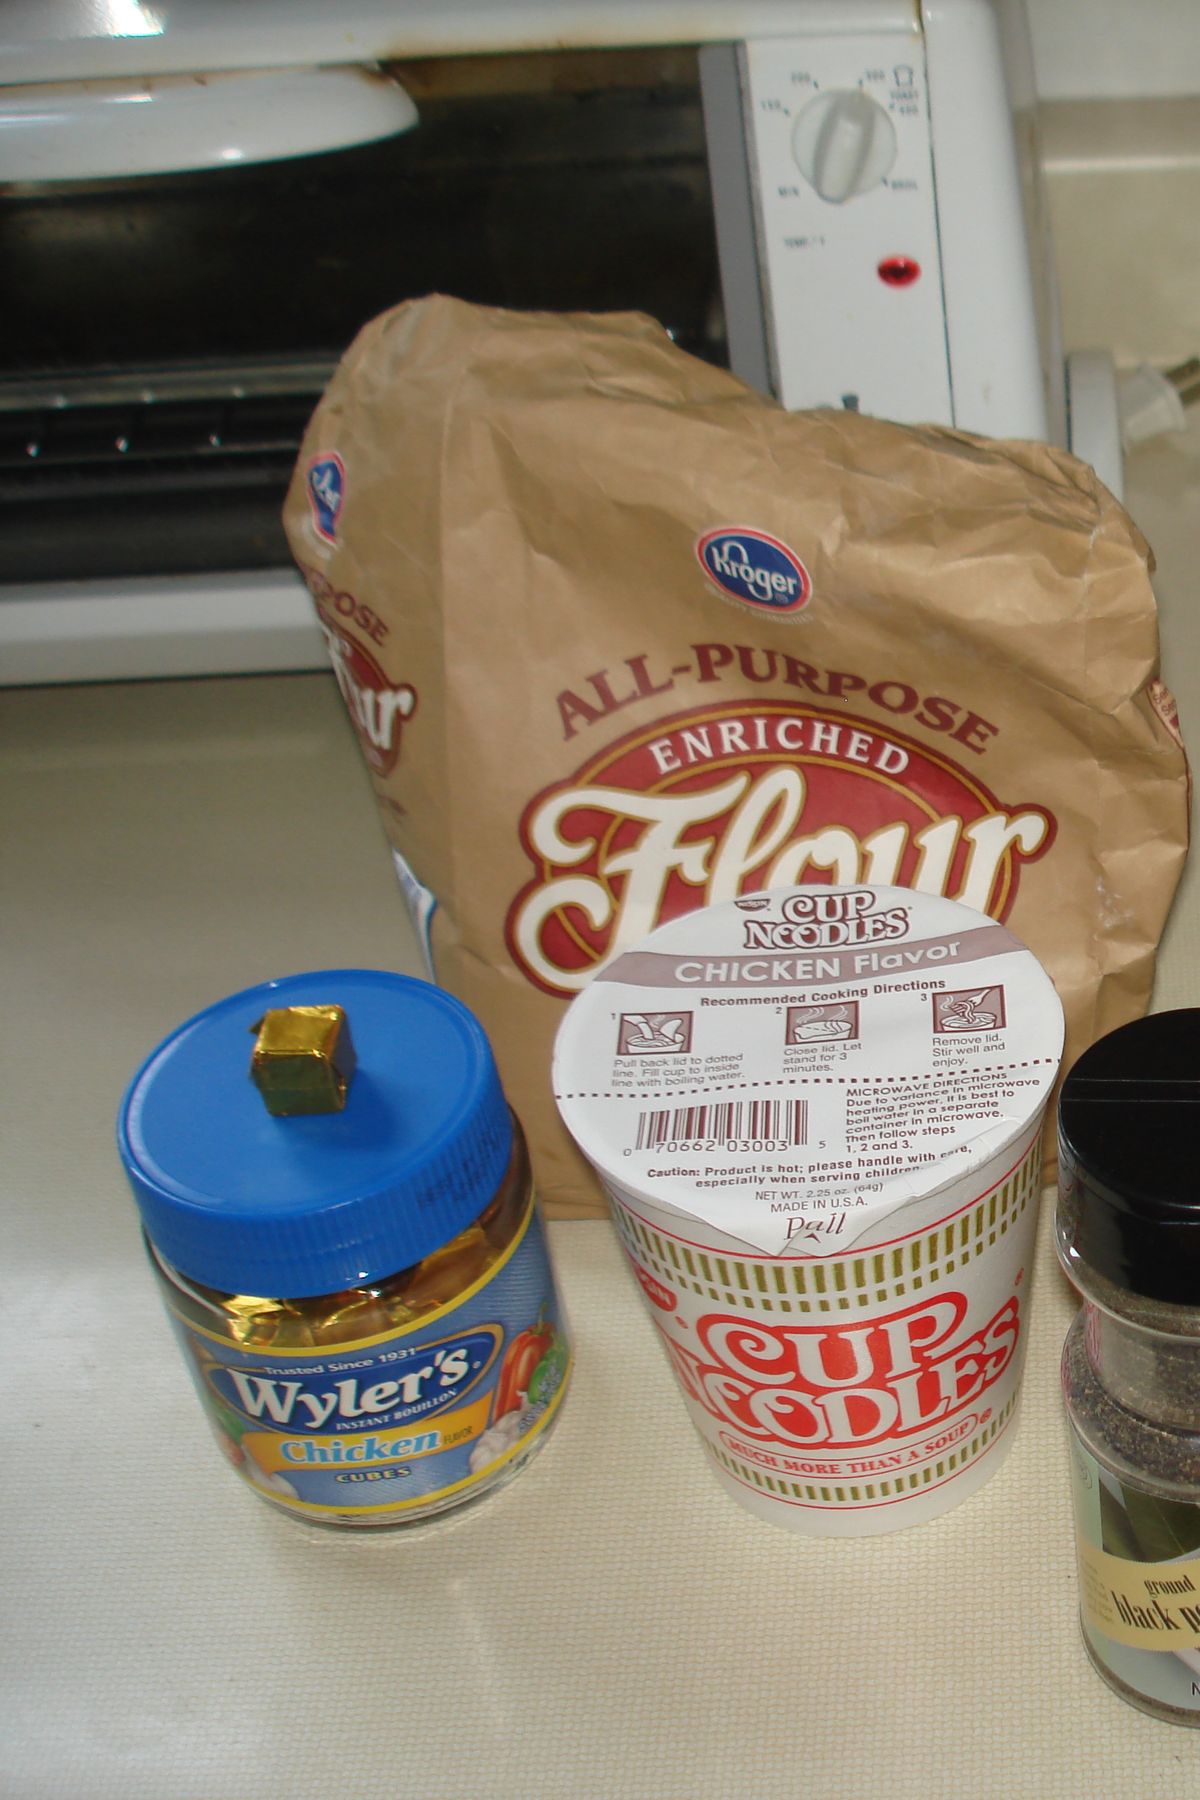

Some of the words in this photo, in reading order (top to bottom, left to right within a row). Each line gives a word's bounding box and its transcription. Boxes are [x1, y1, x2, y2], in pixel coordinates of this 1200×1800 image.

[710, 540, 798, 602] Kroger
[554, 642, 999, 756] ALL-PURPOSE
[648, 717, 910, 775] ENRICHED
[782, 890, 877, 923] CUP
[743, 906, 910, 951] NOODLES
[674, 958, 841, 984] CHICKEN
[853, 941, 961, 975] Flavor
[700, 994, 806, 1007] Recommended
[811, 986, 868, 1003] Cooking
[873, 979, 947, 994] Directions
[921, 993, 928, 1002] 3
[775, 1006, 783, 1015] 2
[783, 1047, 817, 1057] Close
[843, 1043, 862, 1052] Let
[932, 1036, 977, 1047] Remove
[932, 1047, 953, 1057] Stir
[956, 1045, 979, 1055] well
[983, 1042, 1005, 1053] and
[614, 1059, 637, 1068] Pull
[640, 1058, 670, 1067] back
[673, 1057, 687, 1066] lid
[690, 1057, 701, 1065] to
[705, 1053, 743, 1064] dotted
[663, 1068, 685, 1078] cup
[704, 1062, 740, 1073] inside
[783, 1054, 817, 1065] stand
[819, 1053, 836, 1062] for
[839, 1052, 847, 1061] 3
[783, 1063, 833, 1074] minutes.
[932, 1057, 968, 1069] enjoy.
[637, 1078, 662, 1087] with
[846, 1083, 930, 1097] MICROWAVE
[933, 1072, 1008, 1088] DIRECTIONS
[846, 1098, 872, 1107] Due
[875, 1096, 888, 1104] to
[891, 1088, 949, 1102] variance
[967, 1078, 1041, 1092] microwave
[846, 1105, 895, 1117] heating
[971, 1090, 998, 1100] best
[1002, 1089, 1015, 1097] to
[846, 1116, 870, 1126] boil
[873, 1111, 909, 1123] water
[913, 1107, 924, 1115] in
[940, 1100, 999, 1113] separate
[845, 1119, 907, 1134] container
[911, 1116, 923, 1125] in
[926, 1109, 1004, 1124] microwave.
[845, 1133, 876, 1143] Then
[879, 1129, 918, 1140] follow
[921, 1125, 956, 1136] steps
[623, 1147, 632, 1157] 0
[655, 1139, 716, 1154] 70662
[727, 1140, 789, 1153] 03003
[819, 1140, 827, 1150] 5
[860, 1143, 868, 1152] 2
[871, 1141, 897, 1151] and
[901, 1139, 913, 1149] 3.
[647, 1166, 701, 1178] Caution:
[704, 1165, 757, 1177] Product
[761, 1164, 773, 1174] is
[807, 1161, 852, 1174] please
[857, 1155, 903, 1168] handle
[907, 1152, 936, 1164] with
[696, 1174, 767, 1188] especially
[770, 1174, 806, 1184] when
[810, 1170, 861, 1184] serving
[755, 1191, 778, 1201] NET
[806, 1188, 831, 1198] 2.25
[853, 1182, 884, 1194] (64g)
[770, 1202, 809, 1213] MADE
[812, 1199, 826, 1210] IN
[830, 1196, 868, 1208] U.S.A.
[698, 1292, 965, 1389] CUP
[265, 1364, 324, 1376] Trusted
[327, 1358, 374, 1373] Since
[378, 1347, 417, 1364] 1931
[664, 1298, 1020, 1450] NOODLES
[225, 1348, 469, 1430] Wyler's
[335, 1414, 390, 1432] INSTANT
[394, 1388, 458, 1421] BOUILLON
[280, 1429, 442, 1465] Chicken
[727, 1440, 779, 1467] MUCH
[783, 1460, 842, 1474] MORE
[846, 1454, 902, 1474] THAN
[908, 1449, 921, 1463] A
[924, 1421, 970, 1454] SOUP
[335, 1465, 412, 1484] CUBES
[1143, 1574, 1197, 1599] ground
[1110, 1590, 1182, 1630] black
